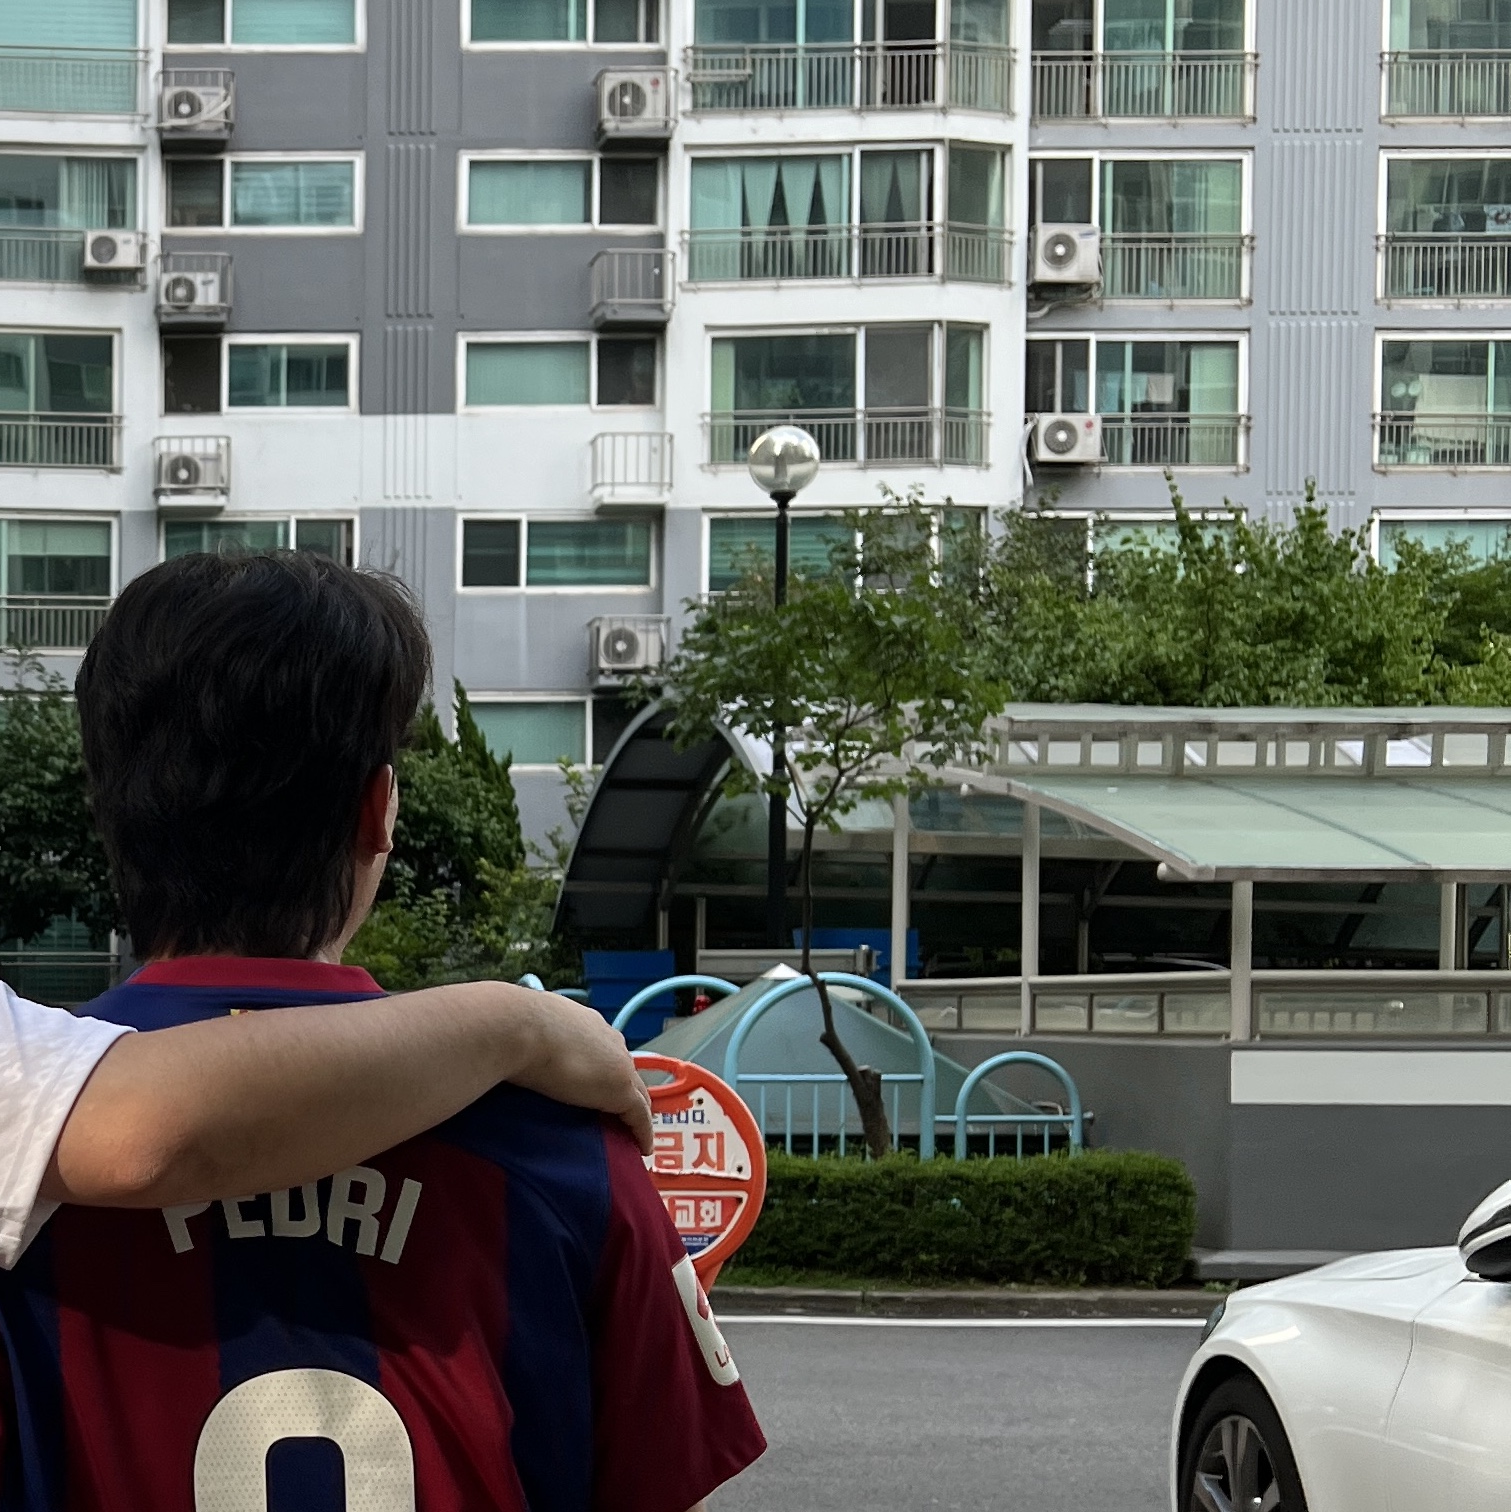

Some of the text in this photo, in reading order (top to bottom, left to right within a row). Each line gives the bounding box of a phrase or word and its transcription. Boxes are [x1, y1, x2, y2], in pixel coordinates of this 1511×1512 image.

[654, 1131, 725, 1171] 금지
[161, 1165, 422, 1265] PEDRI
[664, 1199, 722, 1228] 교회
